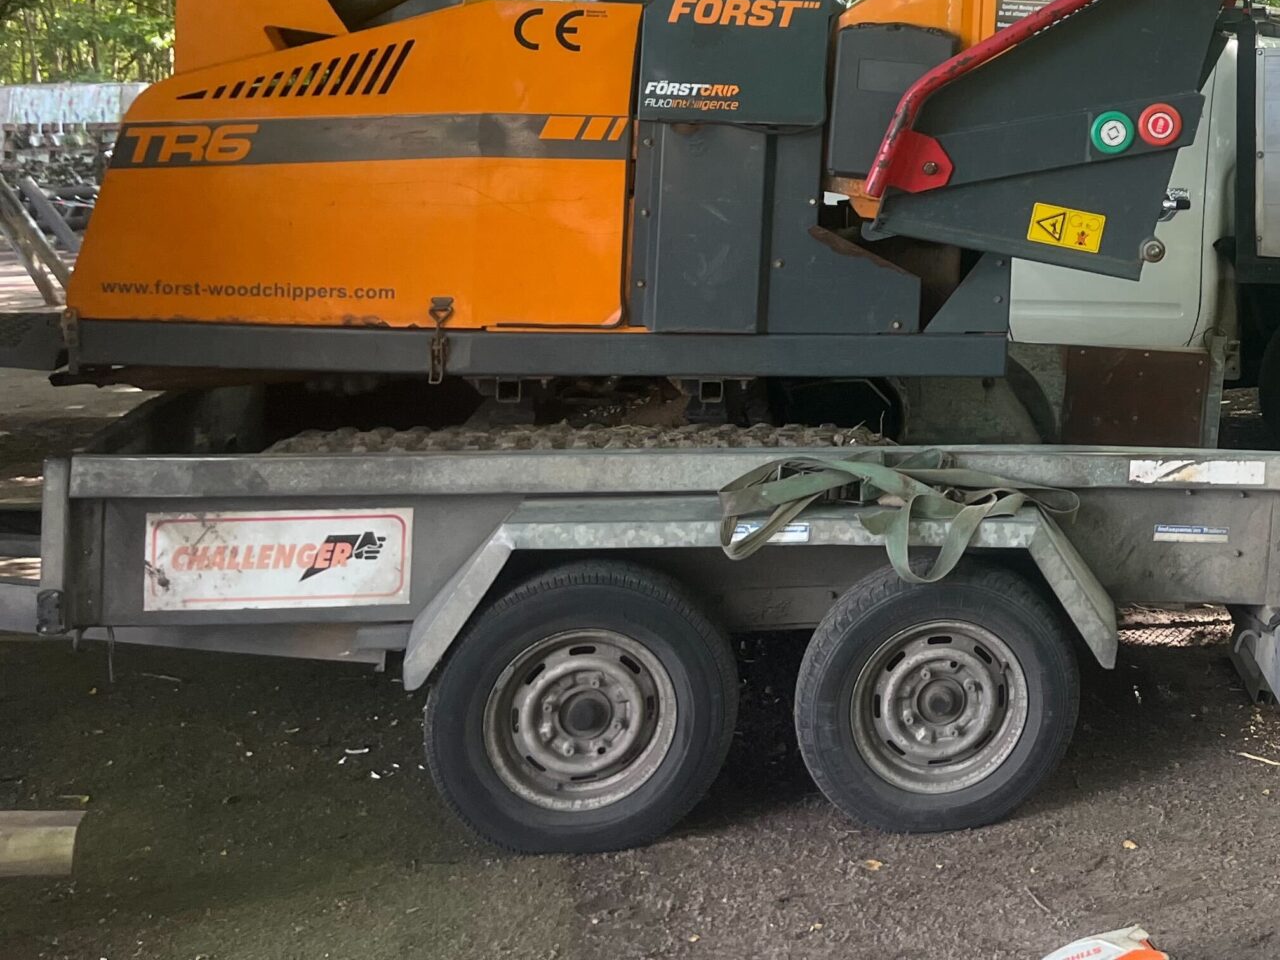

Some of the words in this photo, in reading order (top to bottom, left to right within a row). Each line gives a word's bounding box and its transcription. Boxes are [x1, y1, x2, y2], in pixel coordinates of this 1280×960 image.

[126, 123, 259, 163] TR6
[101, 279, 396, 302] www.forst-woodchippers.com
[171, 541, 353, 572] CHALLENGER
